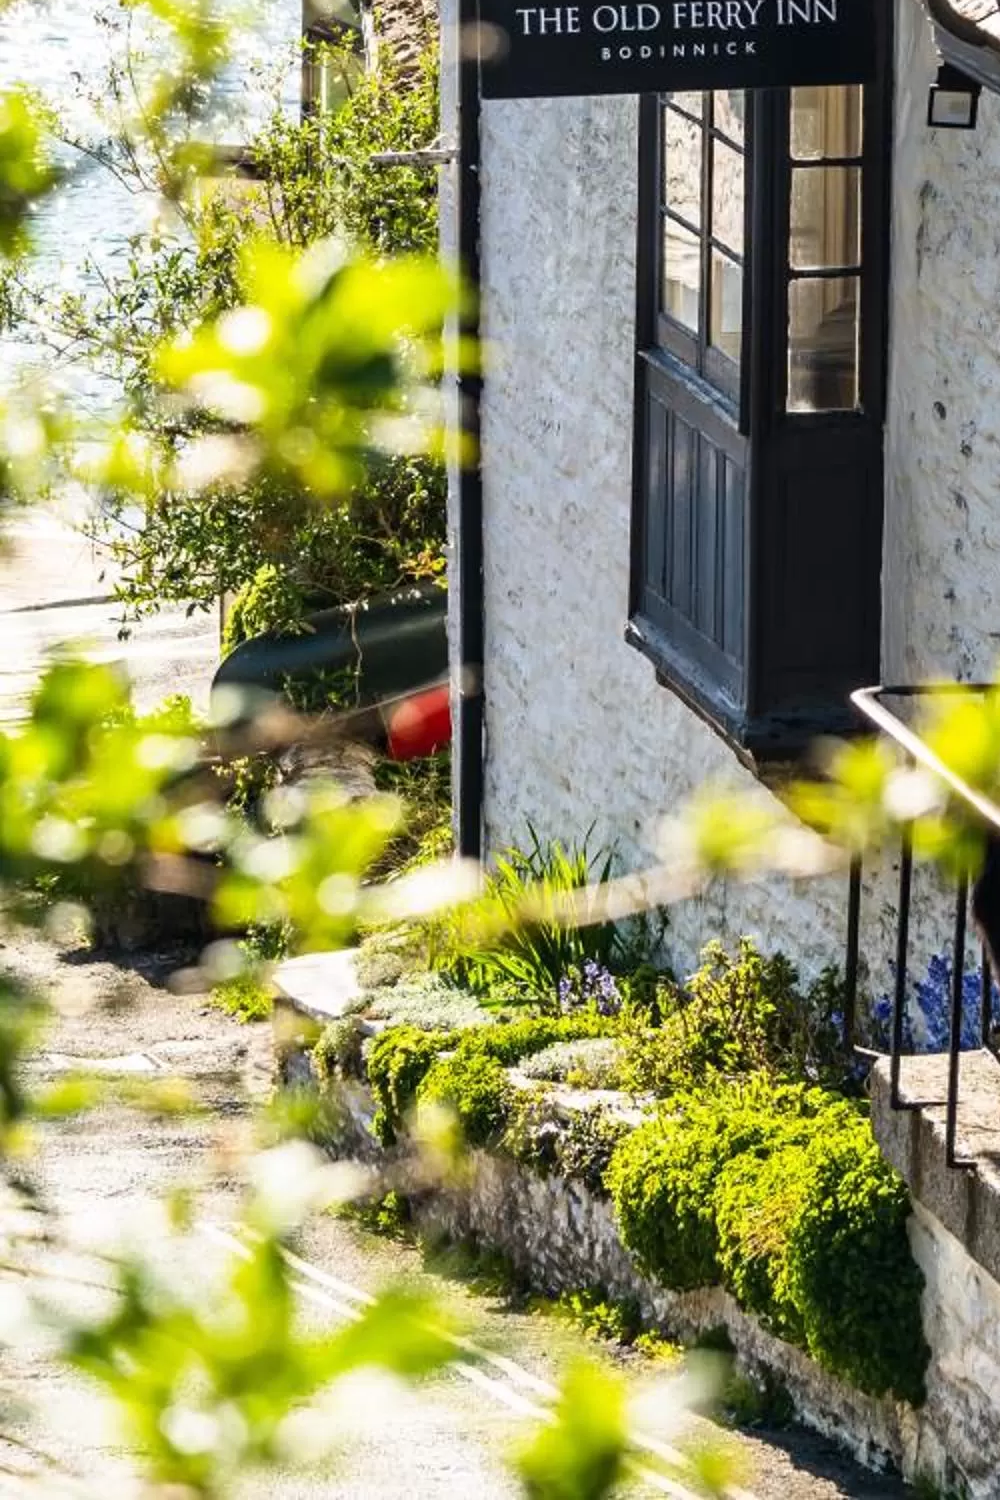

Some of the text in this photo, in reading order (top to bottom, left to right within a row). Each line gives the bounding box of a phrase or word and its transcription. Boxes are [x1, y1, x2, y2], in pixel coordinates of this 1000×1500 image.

[516, 7, 581, 35] THE
[593, 4, 660, 33] OLD
[673, 0, 764, 30] FERRY
[601, 41, 758, 61] BODINNICK
